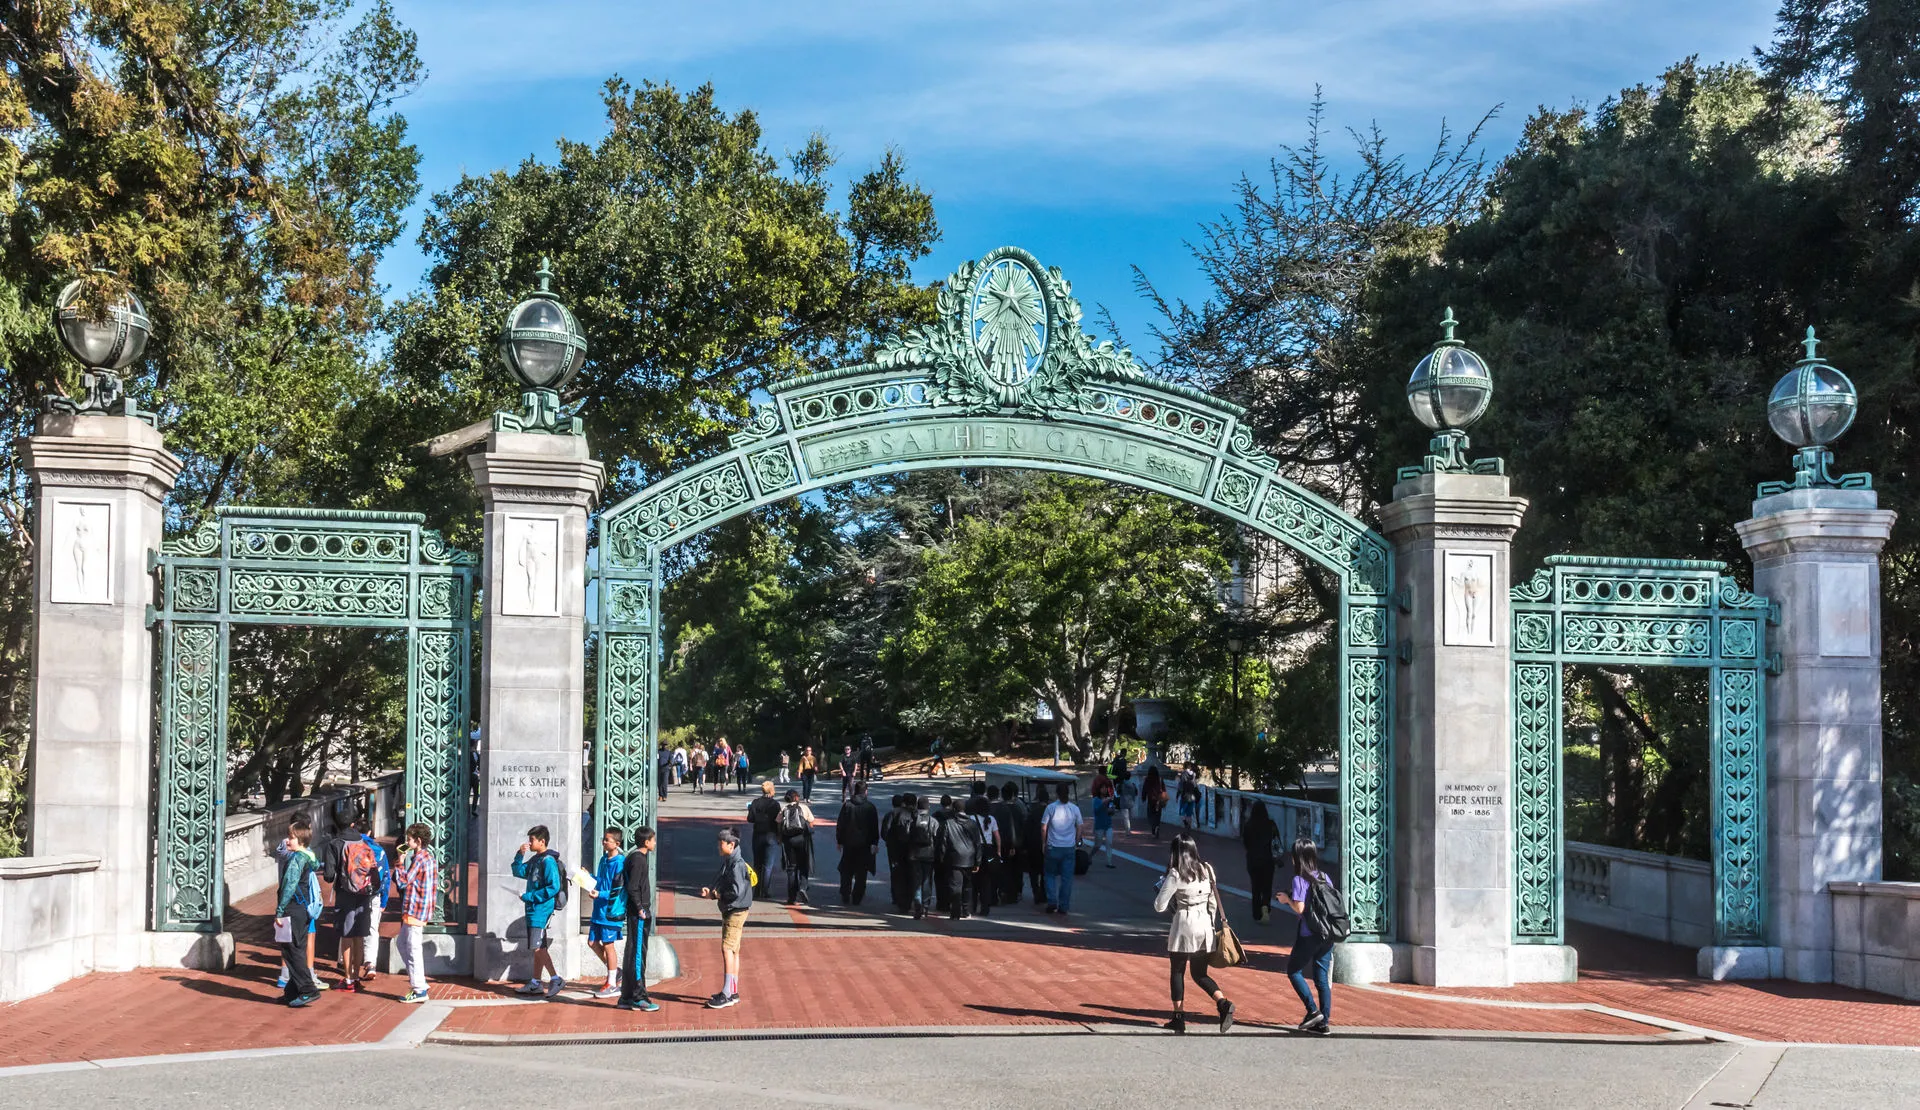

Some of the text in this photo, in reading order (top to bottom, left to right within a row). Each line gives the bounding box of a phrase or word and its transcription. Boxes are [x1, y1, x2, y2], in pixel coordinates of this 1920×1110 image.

[880, 424, 1138, 467] SATHER GATE
[502, 765, 557, 773] ERECTED BY
[490, 777, 515, 787] JANE
[530, 777, 567, 788] SATHER
[1444, 784, 1452, 792] IN
[1454, 784, 1485, 792] MEMORY
[1438, 795, 1504, 806] PEDER SATHER
